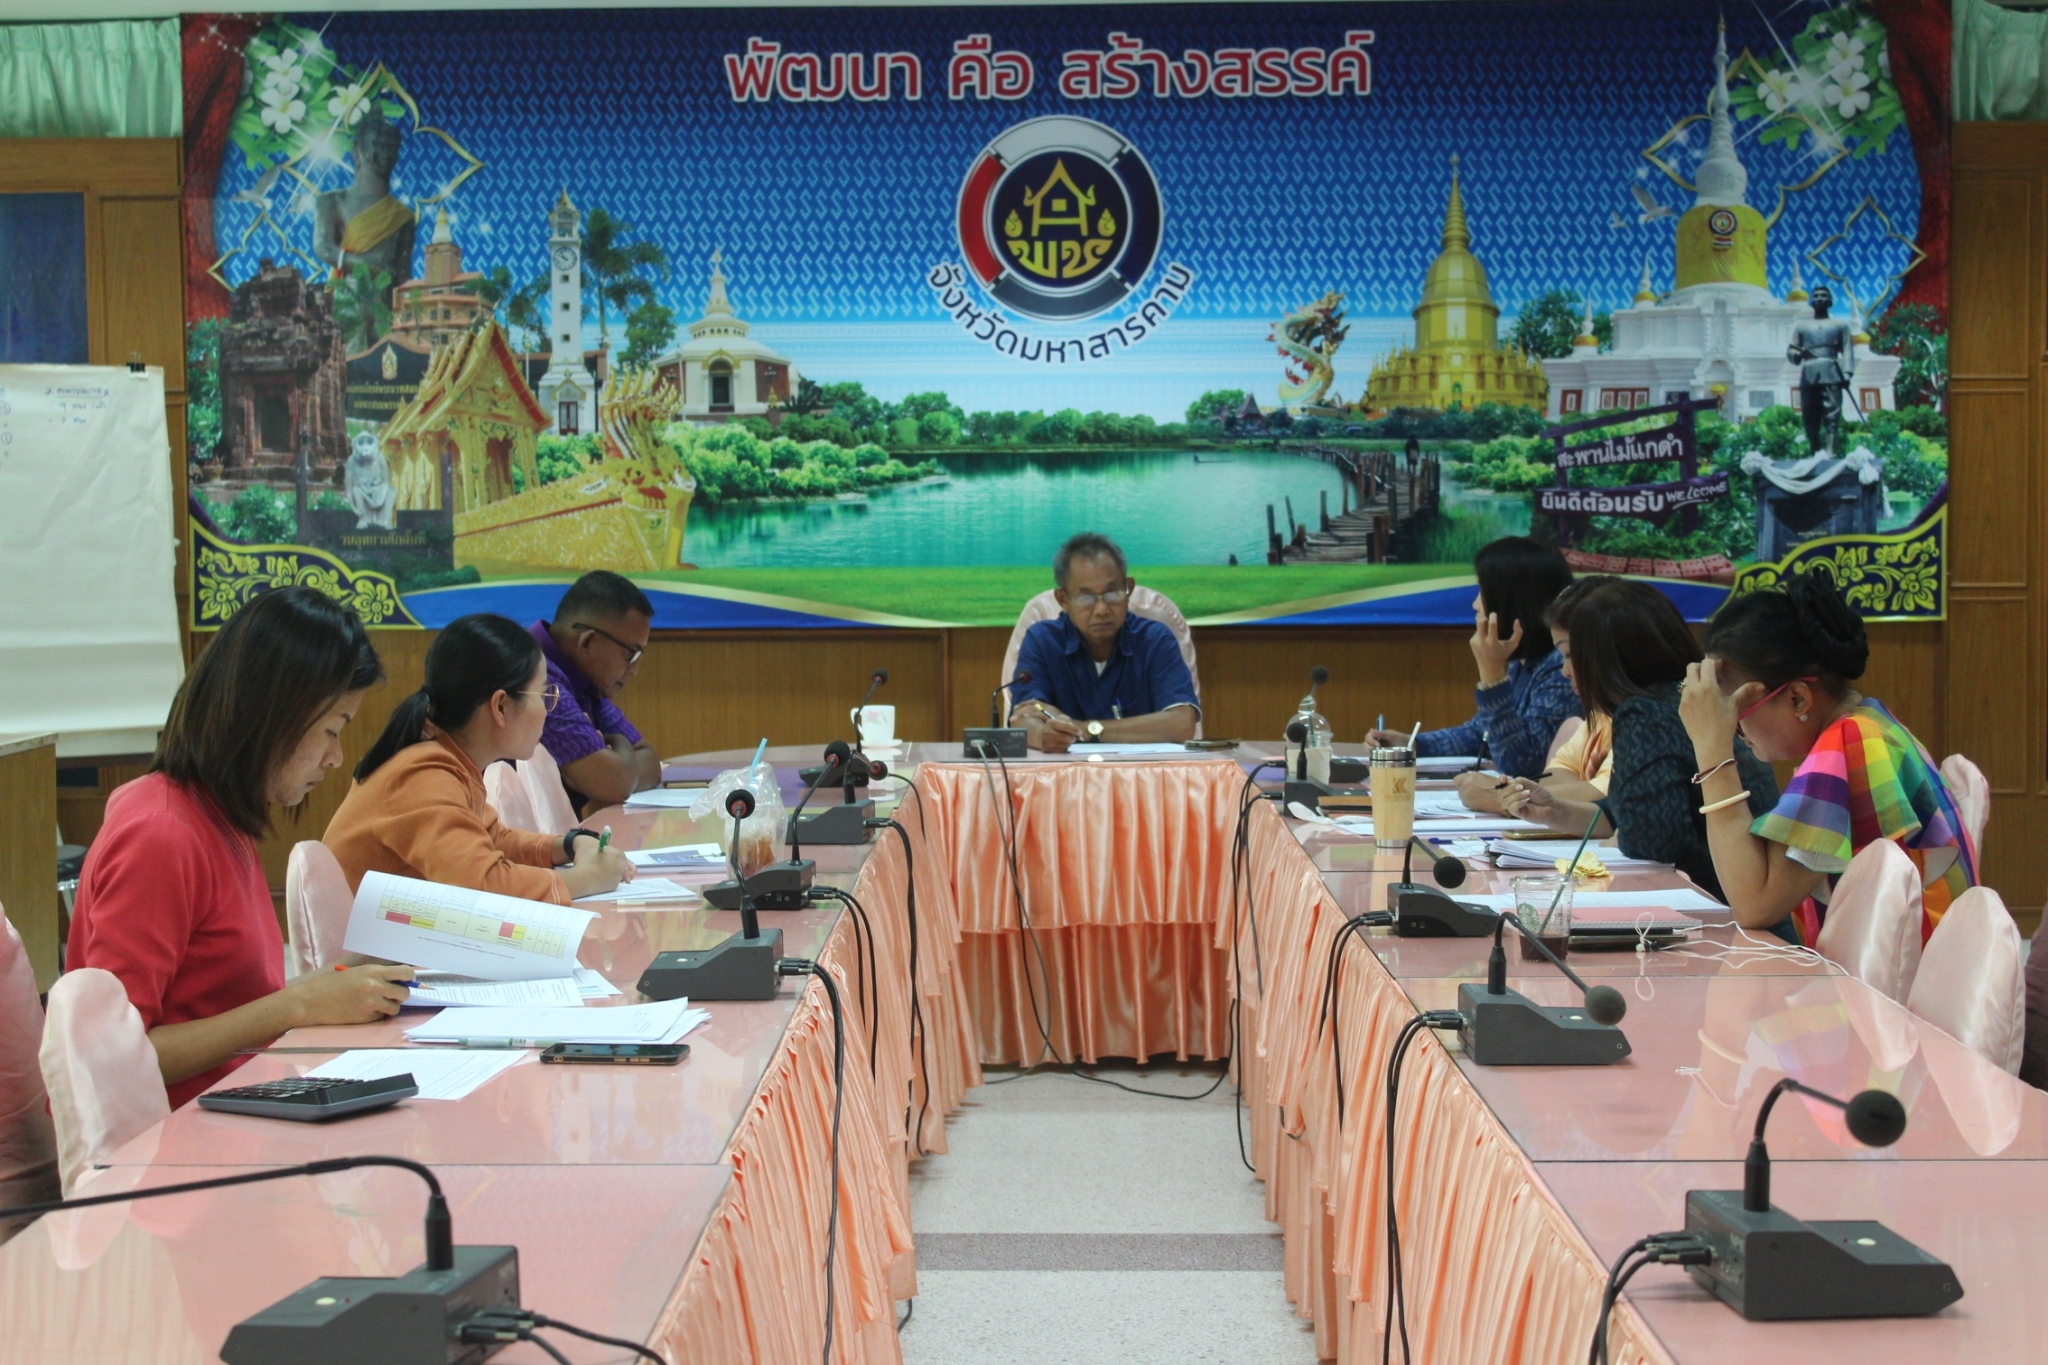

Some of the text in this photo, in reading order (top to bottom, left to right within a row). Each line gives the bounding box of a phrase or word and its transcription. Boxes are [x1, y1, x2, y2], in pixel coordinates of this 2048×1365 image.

[725, 30, 1374, 101] พัฒนา คือ สร้างสรรค์
[929, 263, 1192, 363] จังหวัดมหาสารคาม
[1557, 433, 1683, 468] สะพานไม้แกดำ
[1541, 489, 1665, 513] ยินดีต้อนรับ
[1666, 480, 1728, 502] WELCOME
